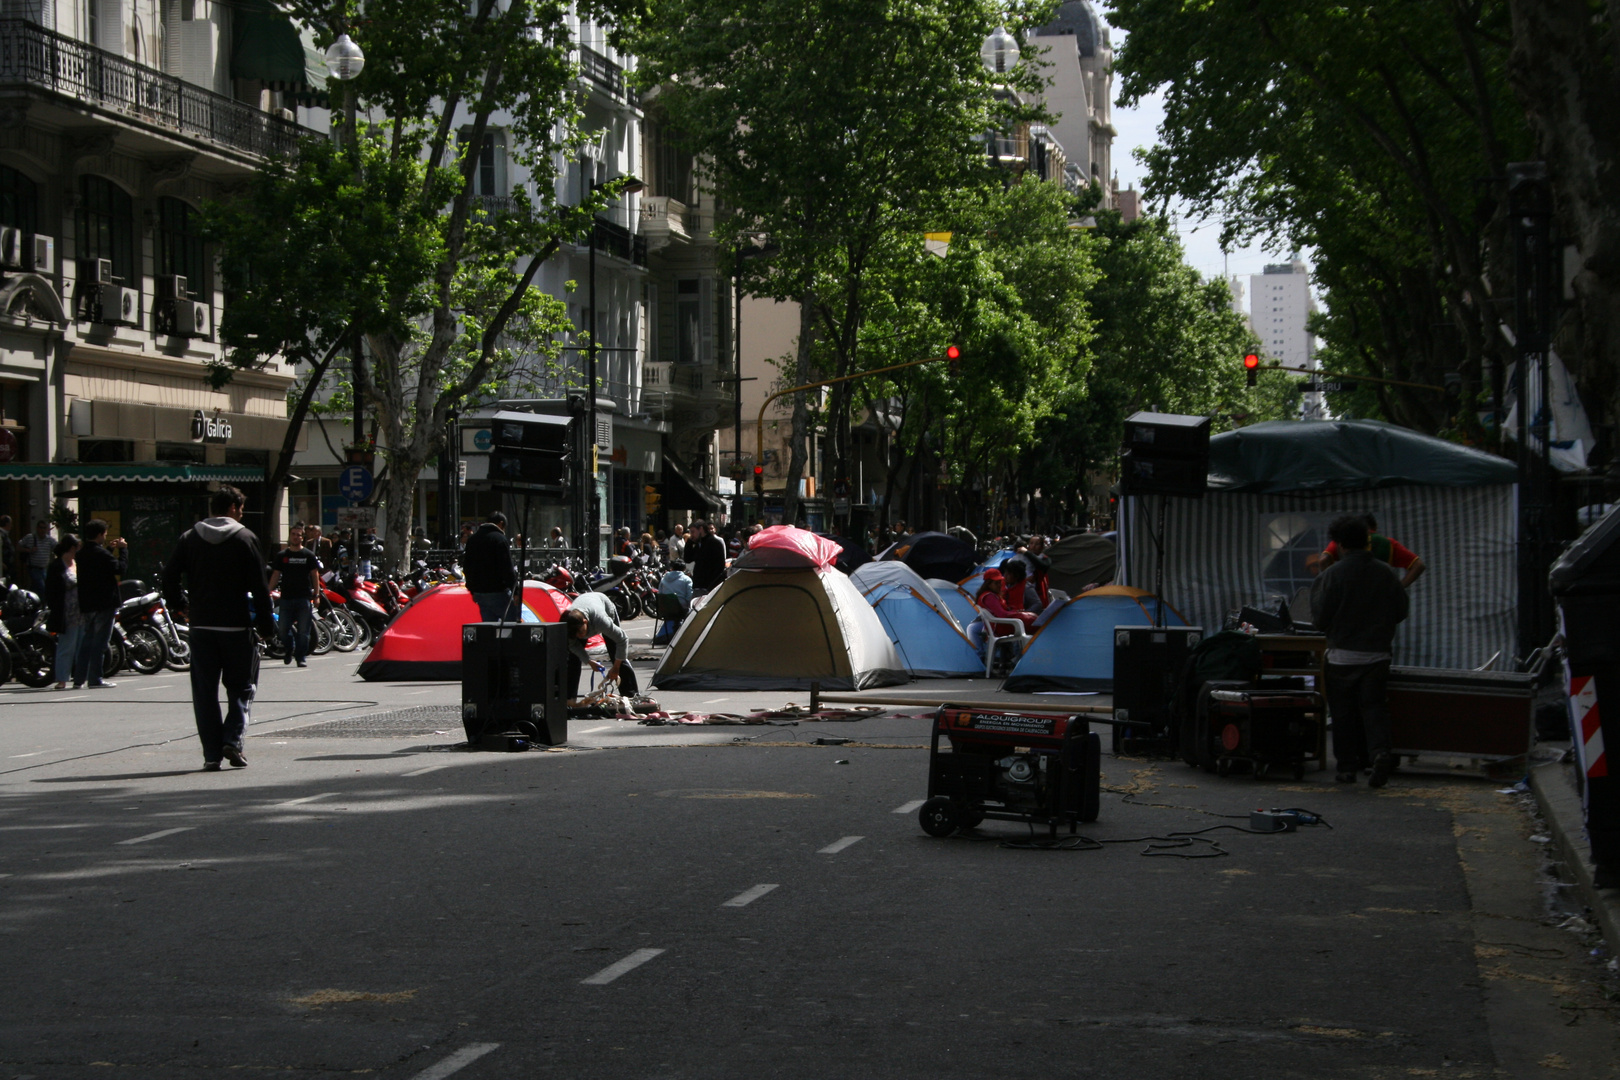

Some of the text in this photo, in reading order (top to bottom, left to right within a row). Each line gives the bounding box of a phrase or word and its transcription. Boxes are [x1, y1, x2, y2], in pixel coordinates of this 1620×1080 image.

[1315, 382, 1341, 391] PERU
[207, 417, 232, 438] Galicia
[349, 468, 364, 487] E
[976, 714, 1053, 724] ALQUIGROUP
